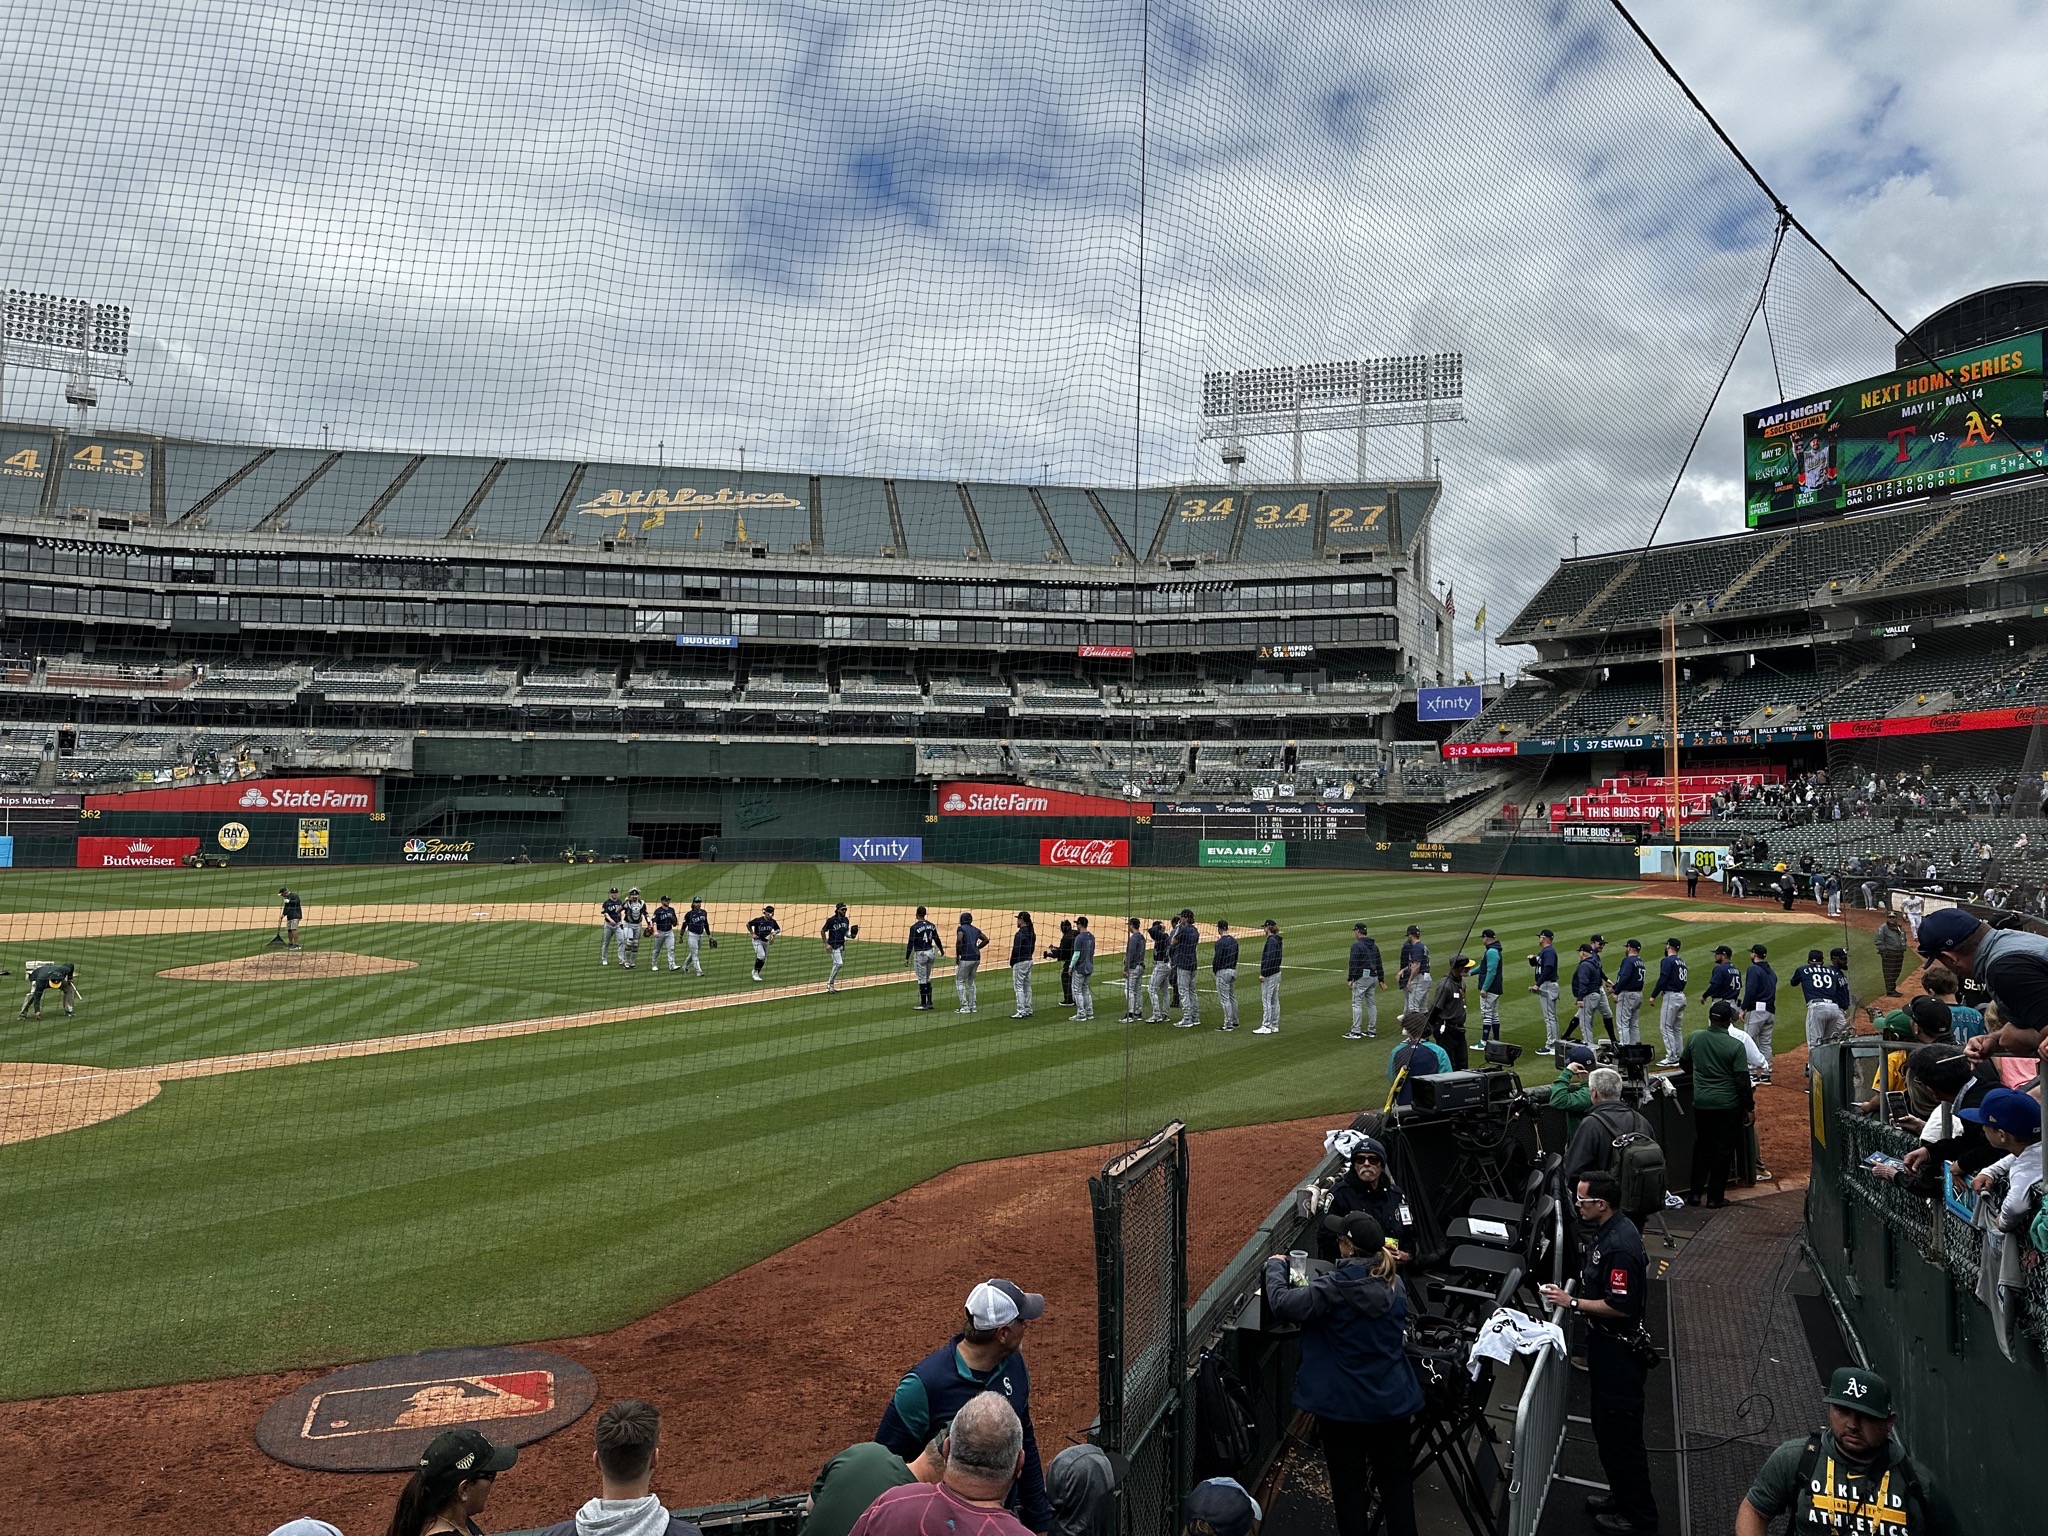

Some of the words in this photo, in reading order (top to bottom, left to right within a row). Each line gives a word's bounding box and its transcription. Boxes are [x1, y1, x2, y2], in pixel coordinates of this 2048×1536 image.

[1861, 383, 1902, 409] NEXT
[1906, 368, 1955, 398] HOME
[1959, 350, 2023, 383] SERIES
[1901, 404, 1924, 418] MAY
[1926, 401, 1936, 412] 11
[1945, 391, 1969, 407] MAY
[1972, 387, 1984, 400] 14
[1757, 411, 1788, 429] AAPI
[1790, 399, 1832, 420] NIGHT
[1770, 423, 1791, 436] SOCKS
[1791, 415, 1825, 429] GIVEAWAY
[1887, 425, 1917, 463] T
[4, 448, 42, 471] 4
[73, 445, 145, 470] 43
[1761, 449, 1774, 460] MAY
[1774, 447, 1782, 456] 12
[2008, 459, 2016, 467] H
[69, 462, 147, 478] ECKERSLEY
[1755, 468, 1774, 481] EAST
[1776, 465, 1790, 476] BAY
[1846, 489, 1863, 498] SEA
[1866, 486, 1873, 494] 0
[1886, 482, 1892, 490] 2
[2017, 453, 2024, 461] 7
[2035, 450, 2042, 458] 0
[1797, 497, 1814, 505] VELO
[1798, 491, 1813, 500] EXIT
[1846, 496, 1863, 506] OAK
[1866, 494, 1873, 502] 0
[576, 487, 800, 517] Athletics
[1180, 497, 1235, 518] 34
[1750, 501, 1769, 510] PITCH
[1253, 503, 1312, 524] 34
[1329, 505, 1386, 528] 27
[1749, 507, 1769, 515] SPEED
[1181, 514, 1228, 524] FINGERS
[1255, 521, 1307, 530] STEWART
[1333, 525, 1380, 534] HUNTER
[1885, 624, 1911, 634] VALLEY
[682, 636, 703, 644] BUD
[703, 637, 732, 645] LIGHT
[1081, 646, 1132, 657] Budweiser
[1426, 695, 1473, 713] xfinity
[1929, 714, 1962, 730] Coca-Cola
[1758, 727, 1778, 735] BALLS
[1781, 725, 1807, 733] STRIKES
[1586, 740, 1600, 750] 37
[1600, 738, 1643, 749] SEWALD
[1692, 738, 1704, 746] 22
[1708, 736, 1728, 745] 2.65
[1733, 735, 1752, 744] 0.76
[1766, 734, 1772, 742] 3
[1791, 732, 1798, 741] 7
[1813, 731, 1824, 739] 10
[1449, 746, 1468, 756] 3:13
[22, 796, 56, 806] Matter
[80, 810, 101, 819] 362
[1275, 806, 1302, 814] Fanatics
[1326, 806, 1354, 814] Fanatics
[1587, 806, 1610, 818] THIS
[369, 812, 386, 822] 388
[925, 815, 939, 824] 388
[1136, 816, 1151, 825] 362
[223, 827, 245, 838] RAY
[1563, 827, 1575, 836] HIT
[1575, 827, 1590, 836] THE
[1590, 827, 1611, 837] BUDS
[300, 848, 326, 856] FIELD
[425, 838, 476, 855] Sports
[852, 839, 910, 861] xfinity
[1050, 839, 1117, 865] Coca-Cola
[1207, 847, 1233, 855] EVA
[1234, 847, 1258, 855] AIR
[1375, 842, 1392, 851] 367
[1416, 843, 1438, 851] OAKLAND
[405, 853, 469, 861] CALIFORNIA
[1409, 851, 1438, 859] COMMUNITY
[1438, 851, 1453, 859] FUND
[1695, 851, 1715, 867] 811
[1637, 967, 1646, 982] 57
[1678, 967, 1688, 982] 88
[1730, 976, 1741, 990] 45
[1812, 973, 1833, 989] 89
[1842, 1377, 1868, 1399] A's
[1810, 1479, 1903, 1508] OKLD
